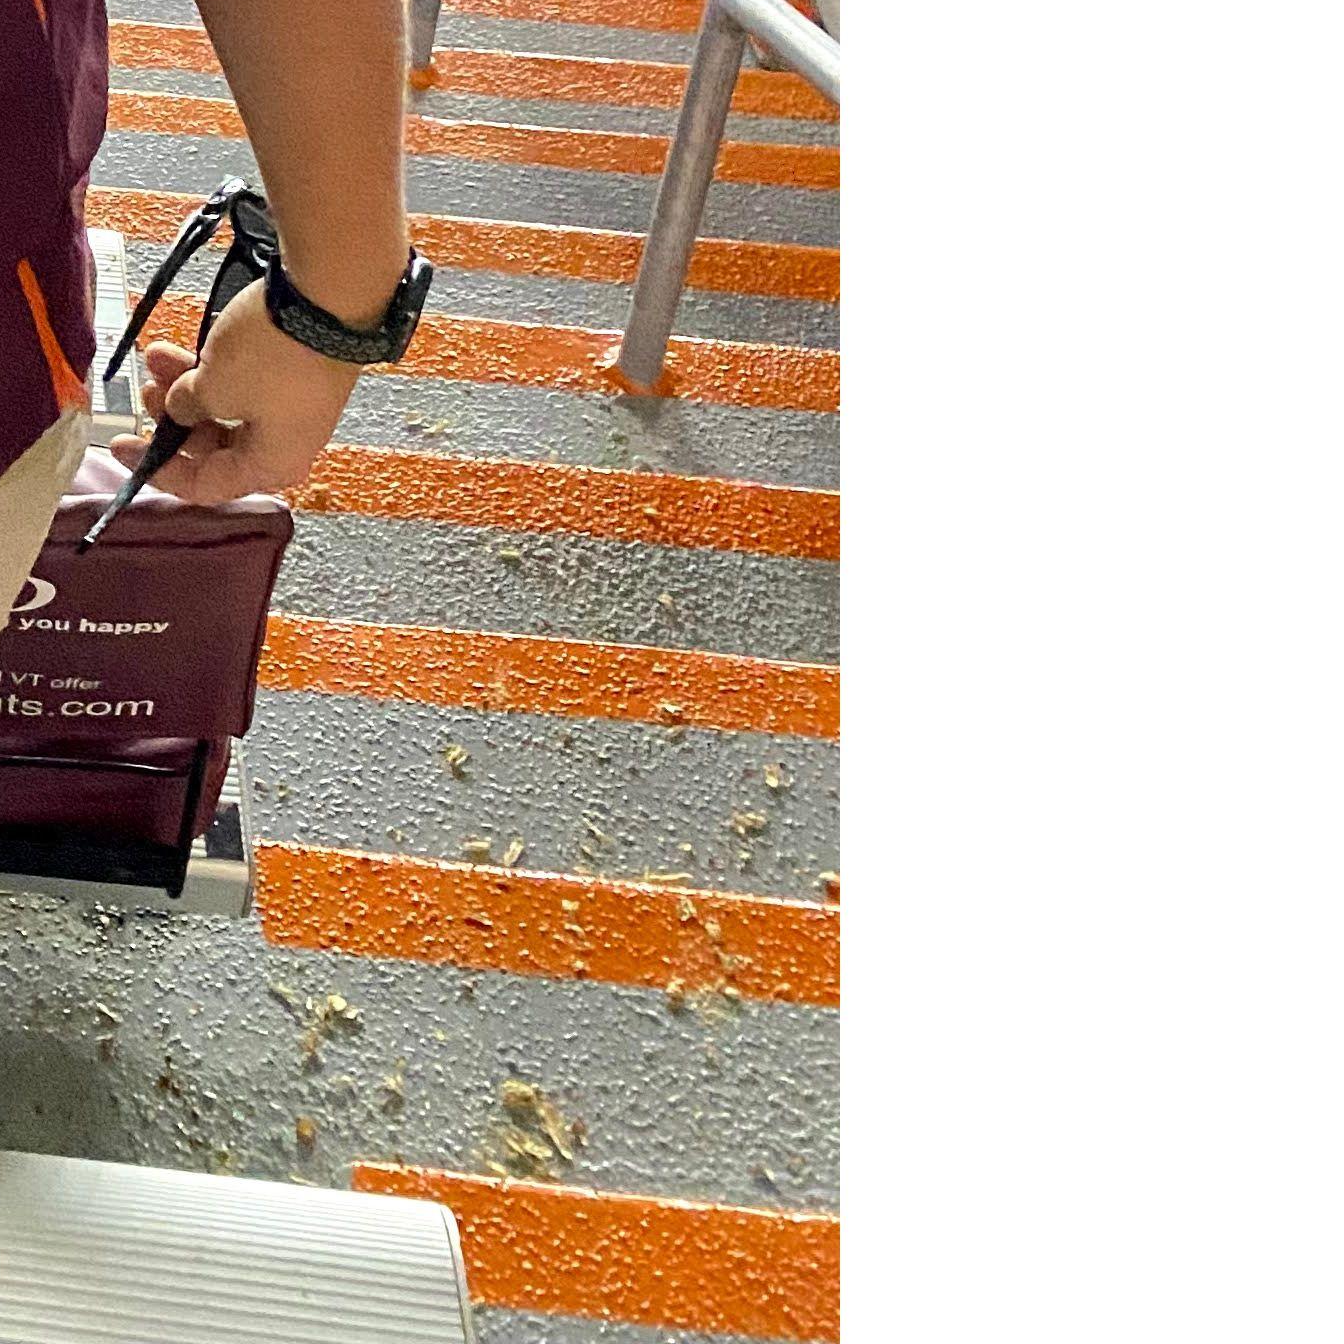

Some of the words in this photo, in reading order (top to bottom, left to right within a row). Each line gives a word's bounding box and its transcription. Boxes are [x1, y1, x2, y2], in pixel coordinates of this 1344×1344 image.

[18, 617, 70, 631] you
[79, 618, 170, 636] happy
[12, 671, 45, 688] VT
[50, 676, 102, 691] offer
